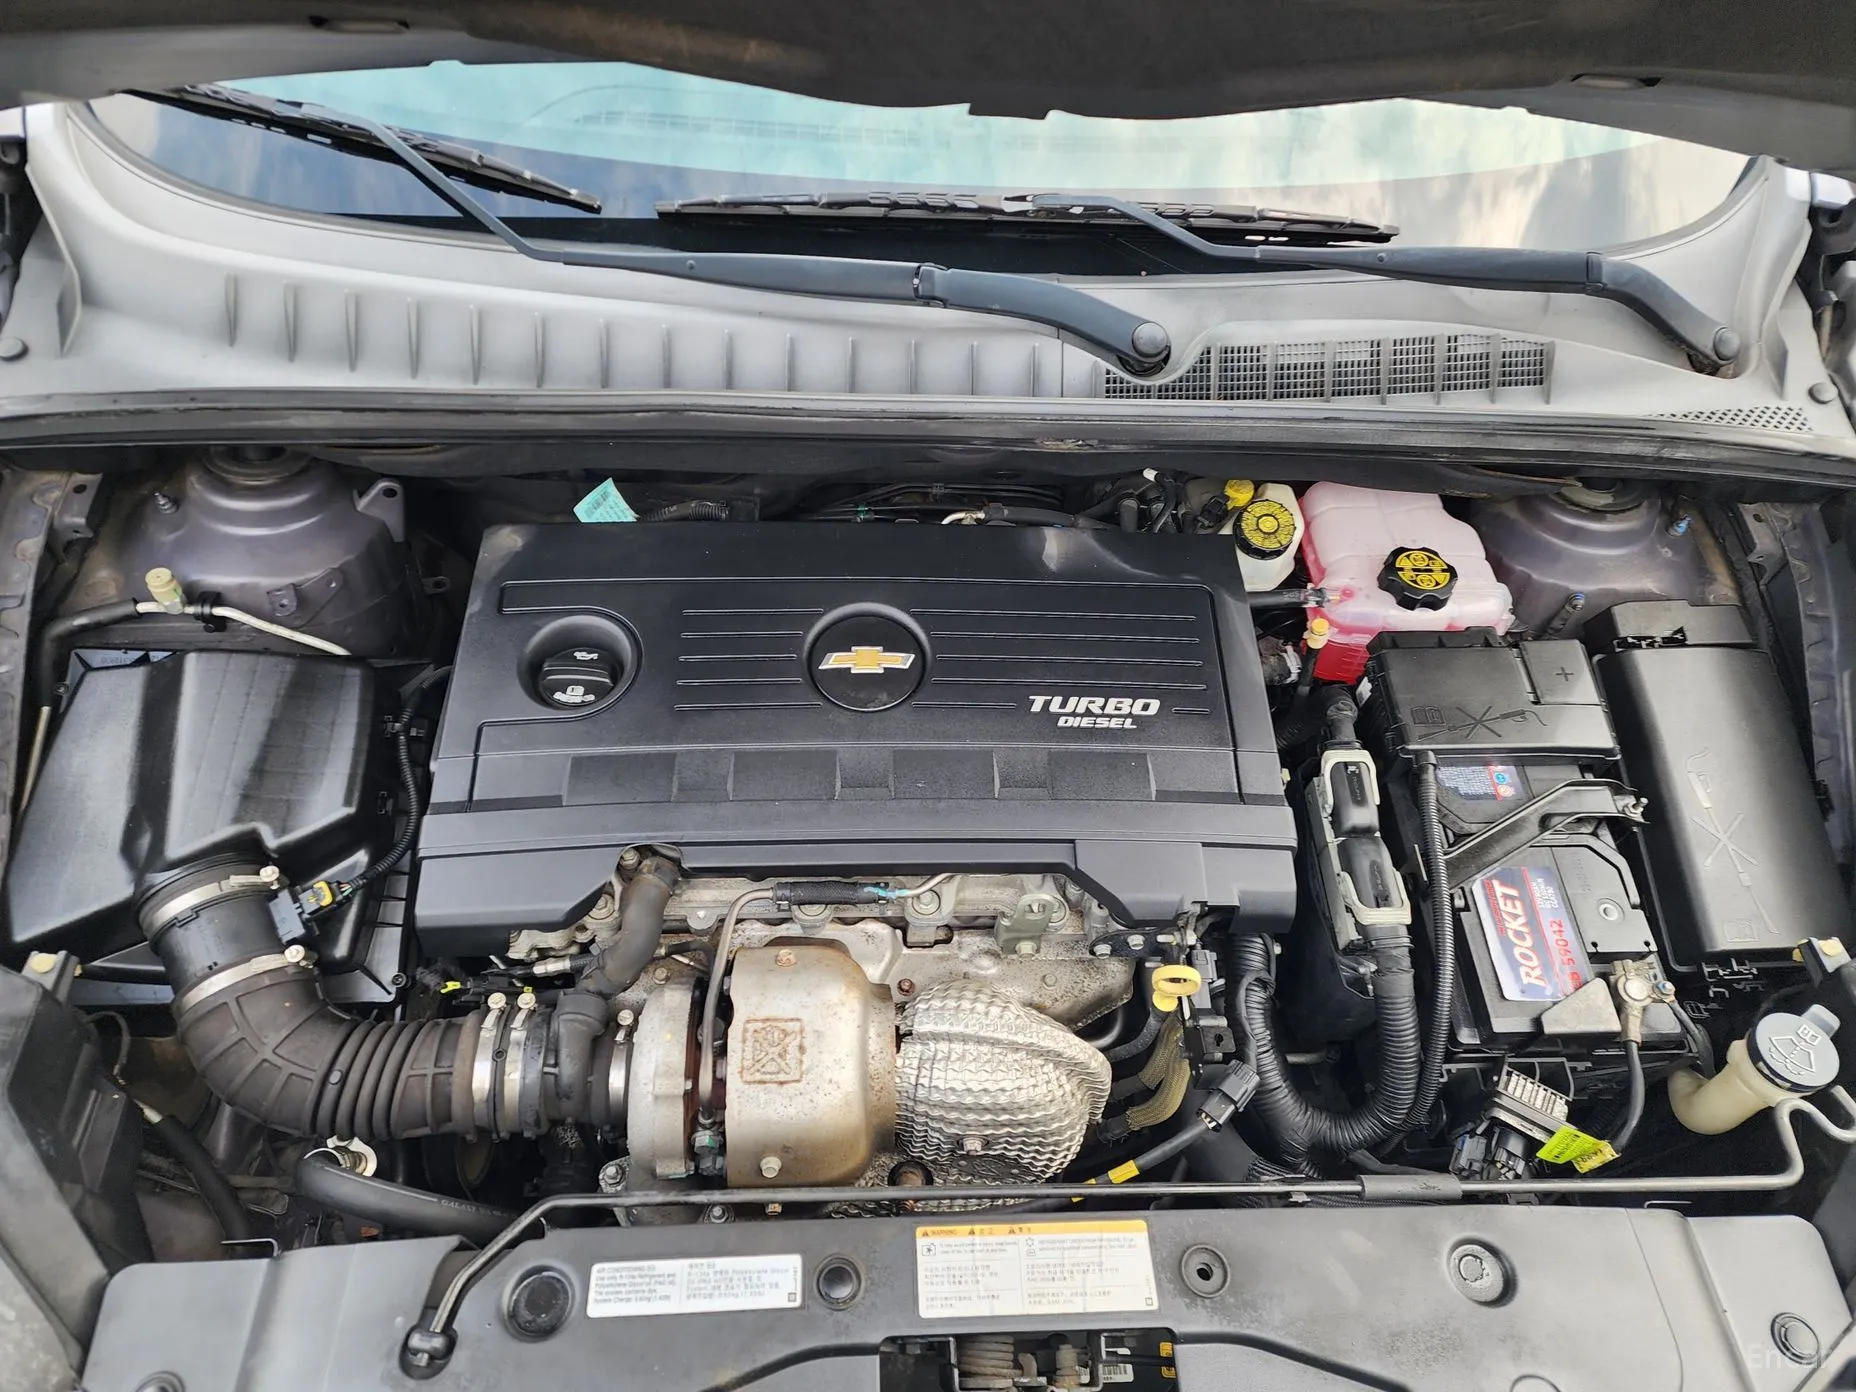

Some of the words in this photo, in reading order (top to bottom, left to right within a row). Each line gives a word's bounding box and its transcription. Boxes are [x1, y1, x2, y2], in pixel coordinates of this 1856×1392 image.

[1028, 695, 1161, 716] TURBO
[1057, 716, 1138, 730] DIESEL
[1492, 879, 1549, 988] ROCKET
[1550, 919, 1577, 966] 59042
